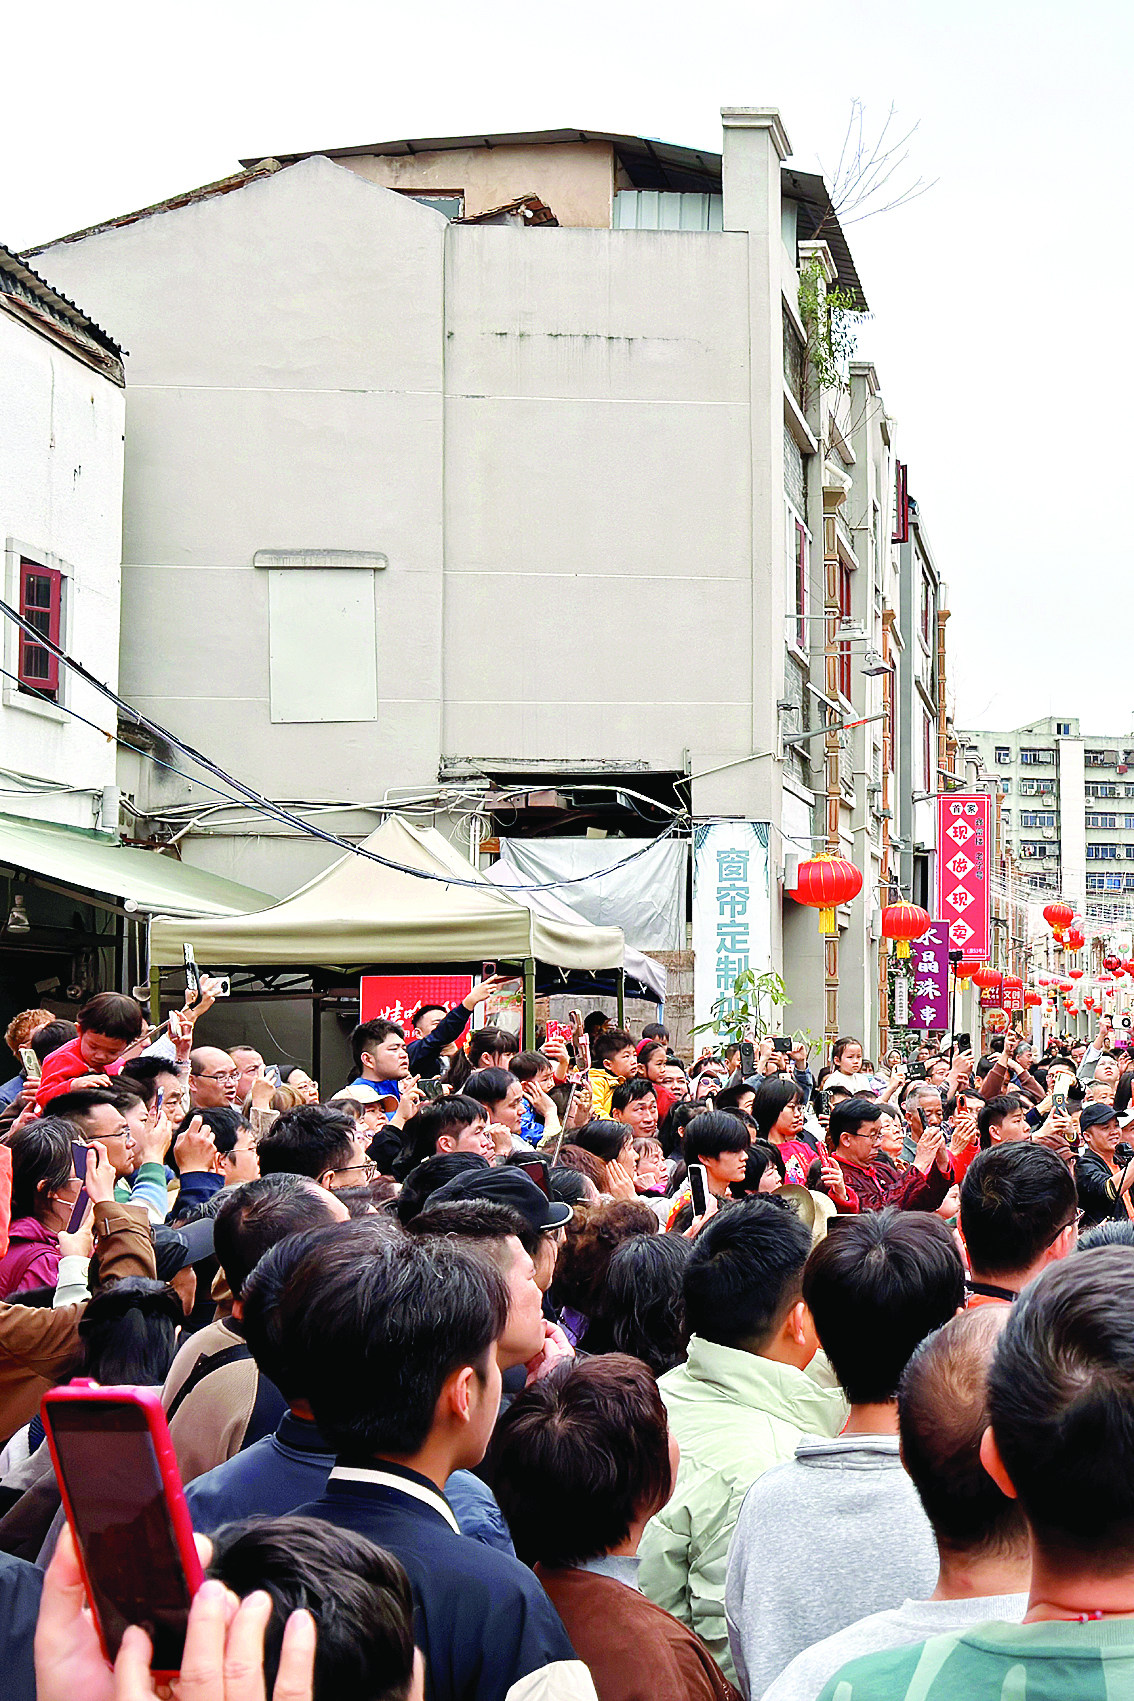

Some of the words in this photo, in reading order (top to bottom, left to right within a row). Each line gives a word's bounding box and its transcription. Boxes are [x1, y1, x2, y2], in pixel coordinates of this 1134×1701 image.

[952, 825, 968, 940] 现做现卖
[913, 926, 943, 1027] 水晶珠串
